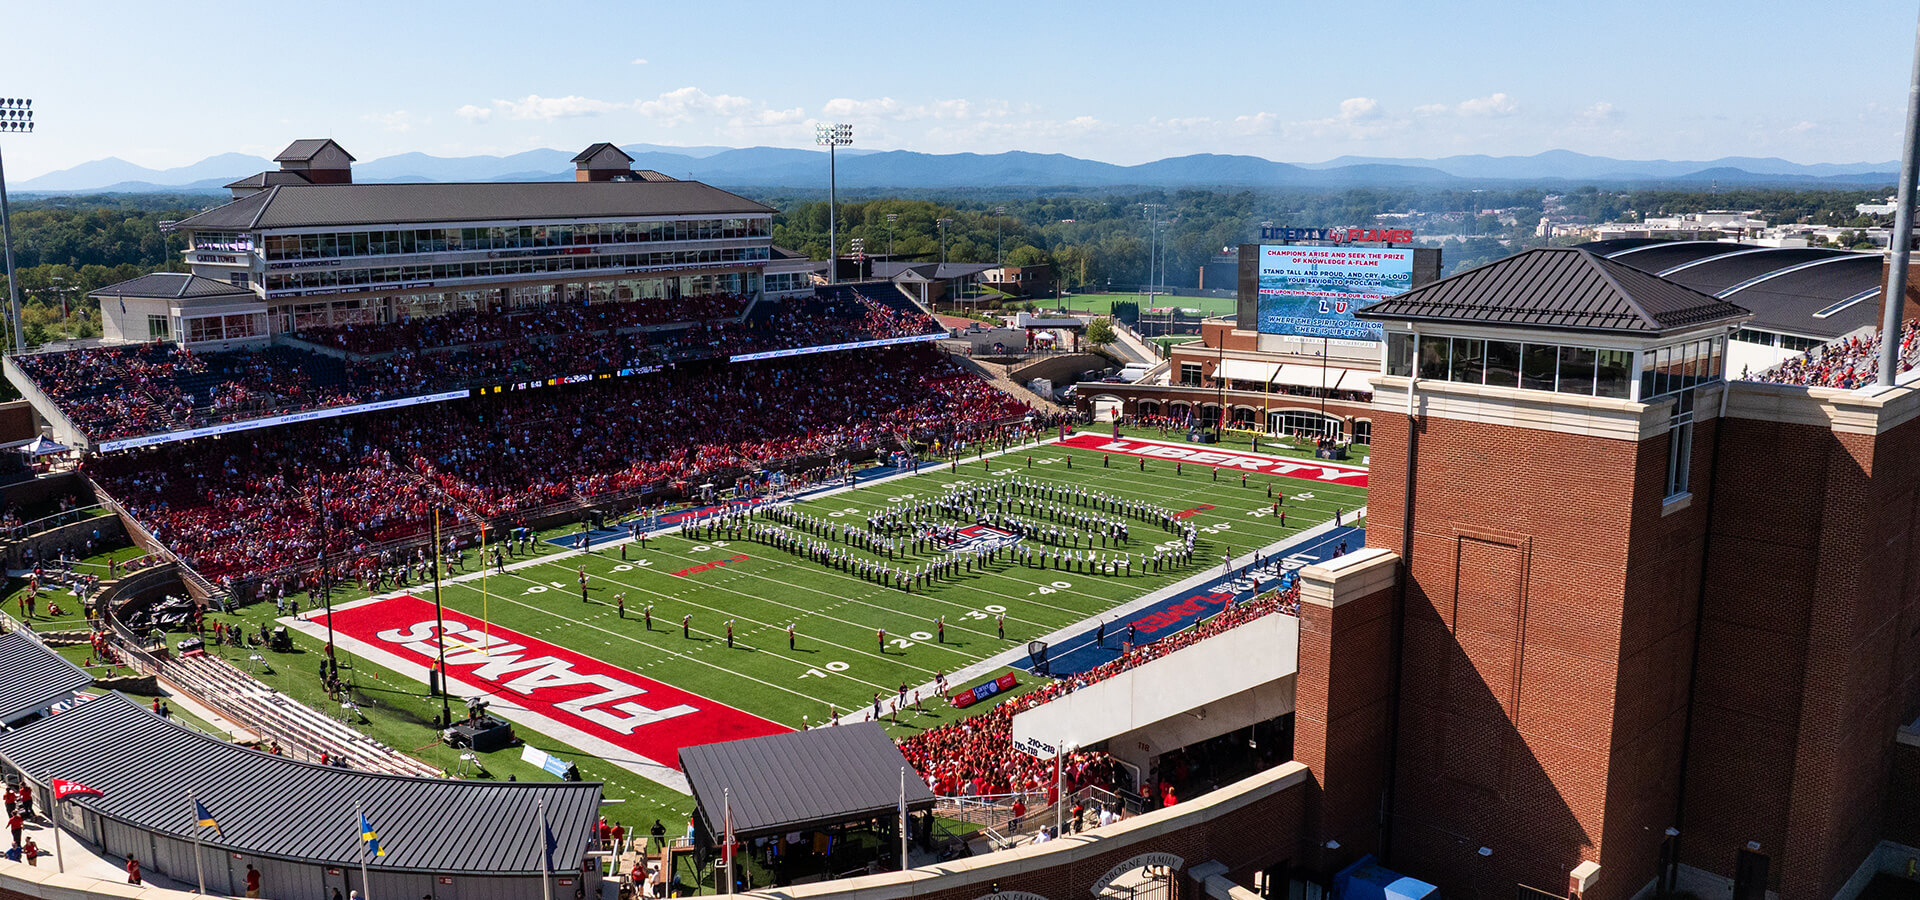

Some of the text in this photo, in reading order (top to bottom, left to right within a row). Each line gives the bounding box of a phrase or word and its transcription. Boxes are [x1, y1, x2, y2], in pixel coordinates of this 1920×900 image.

[1262, 228, 1328, 240] LIBERTY
[1348, 228, 1414, 243] FLAMES
[196, 254, 237, 264] CARTER TOWER
[1320, 301, 1347, 314] L U
[148, 436, 172, 444] REMOVAL
[1096, 440, 1369, 481] LIBERTY
[668, 554, 750, 578] CUSA
[1038, 581, 1072, 595] 40
[965, 605, 1006, 620] 30
[890, 632, 934, 649] 20
[806, 661, 850, 678] 10
[376, 620, 701, 736] FLAMES
[1014, 740, 1038, 756] 110-118
[1028, 737, 1056, 754] 210-218
[1138, 742, 1150, 752] 118
[1097, 854, 1179, 888] OSBORNE FAMILY
